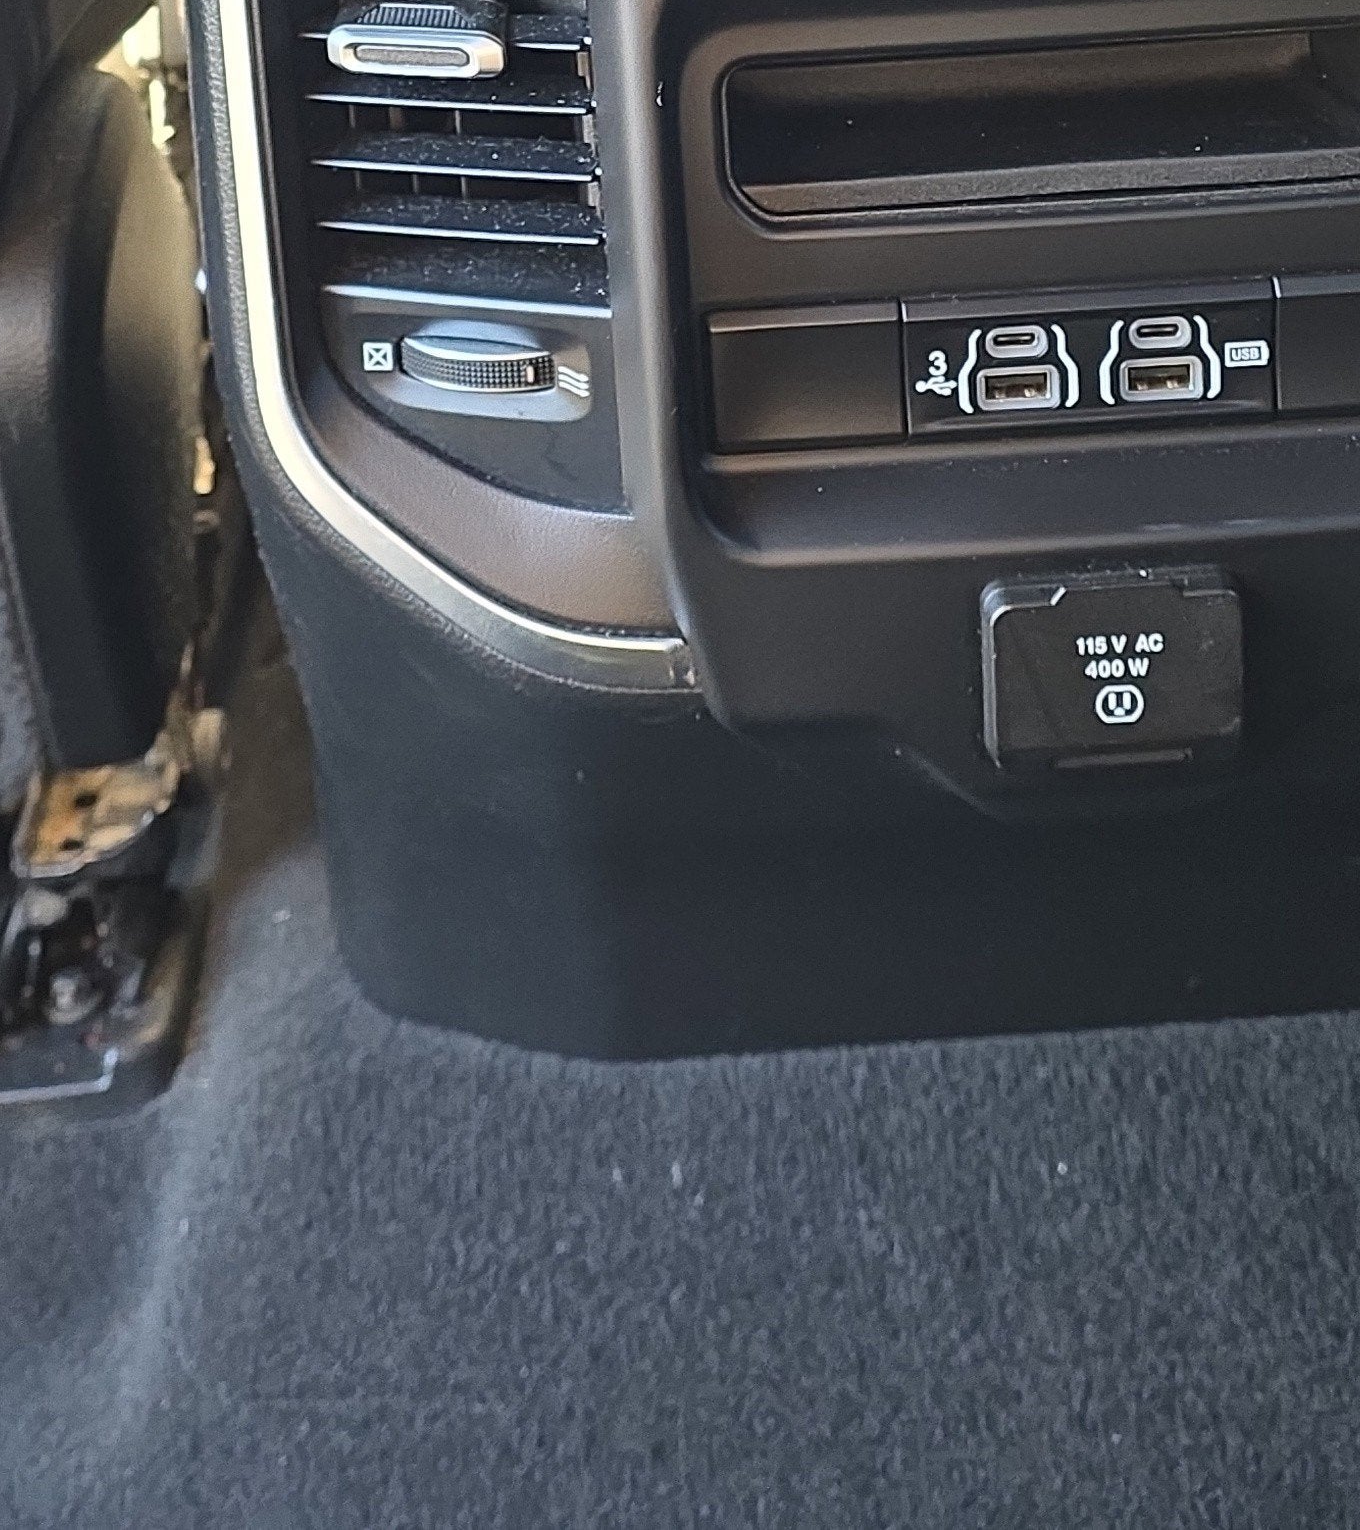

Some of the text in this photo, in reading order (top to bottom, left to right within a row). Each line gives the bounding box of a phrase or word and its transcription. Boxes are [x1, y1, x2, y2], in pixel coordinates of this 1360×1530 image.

[1231, 347, 1260, 361] USB
[1075, 632, 1164, 656] 115 V AC
[1084, 657, 1150, 679] 400 W
